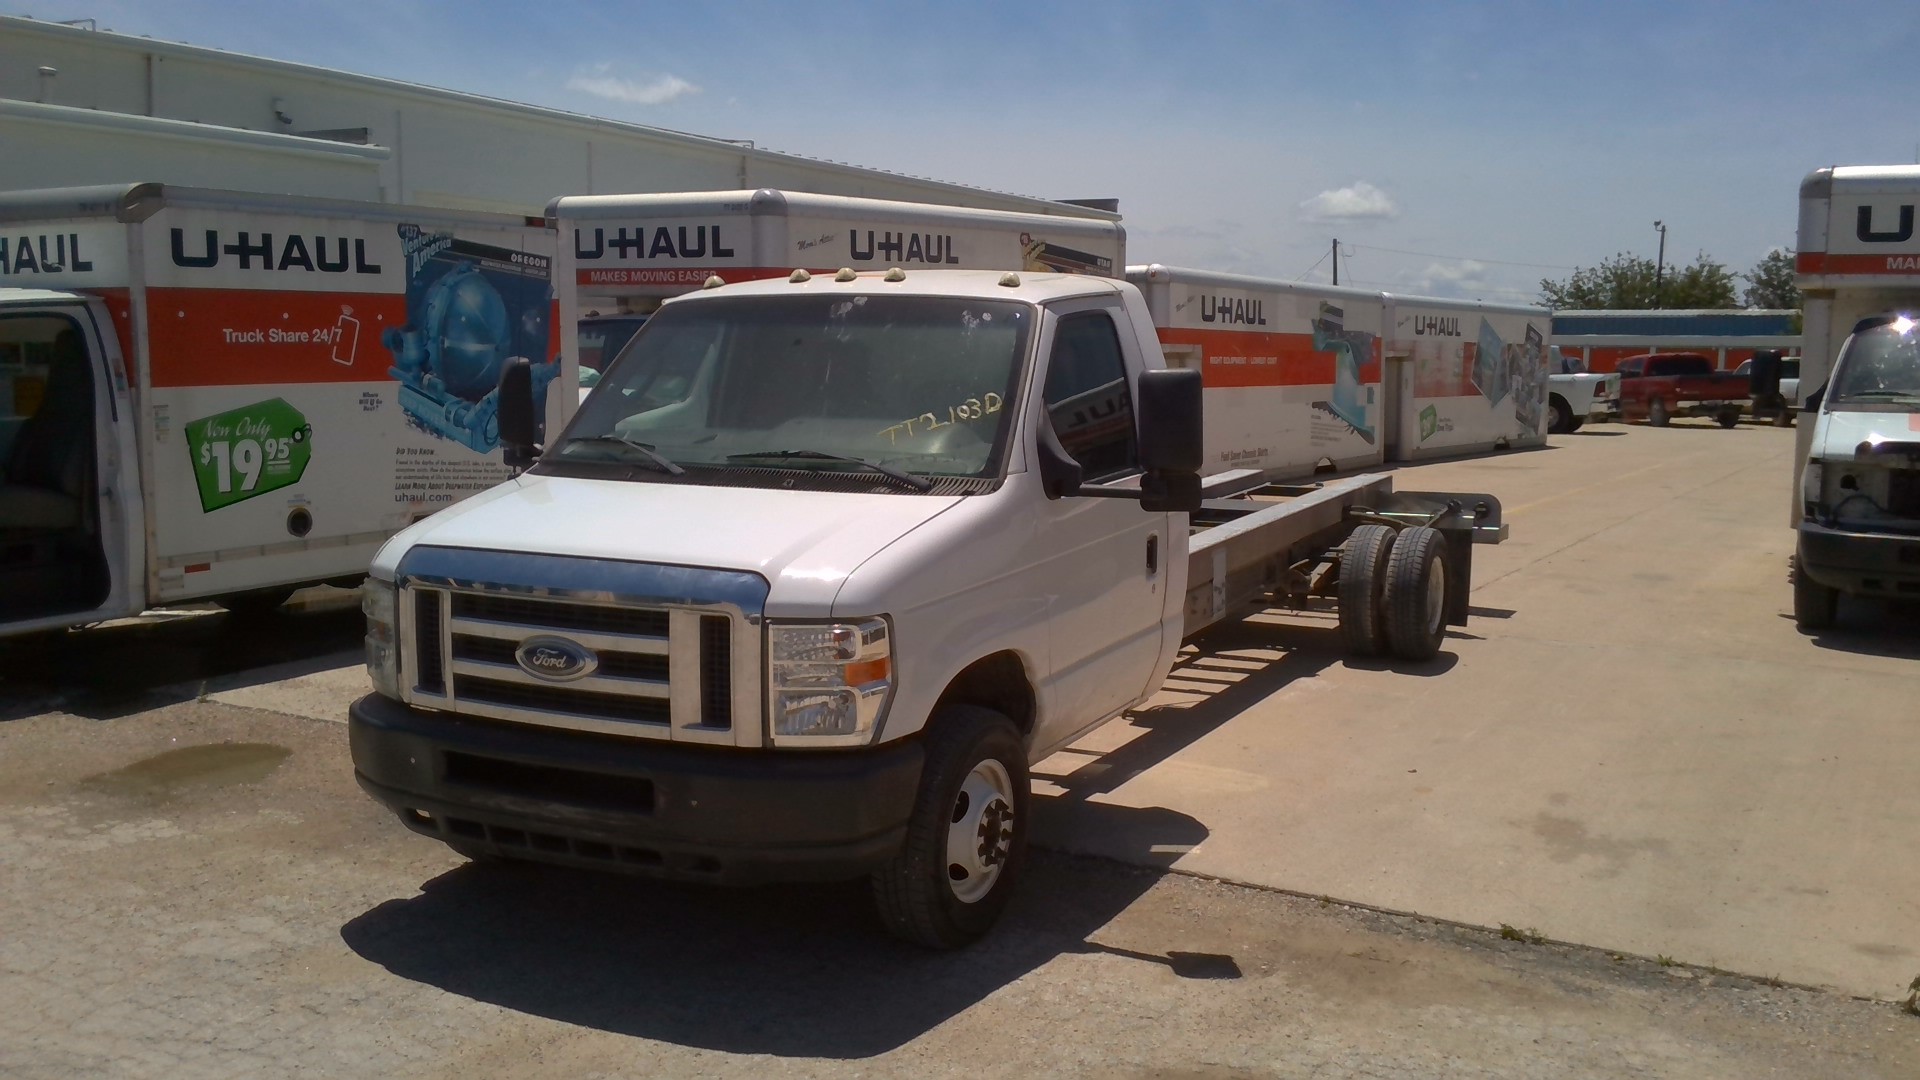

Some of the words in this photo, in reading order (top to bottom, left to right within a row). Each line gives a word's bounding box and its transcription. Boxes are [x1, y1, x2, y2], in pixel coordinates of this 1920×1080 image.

[171, 228, 381, 274] U-HAUL
[575, 226, 734, 259] U-HAUL
[850, 229, 959, 264] U-HAUL
[510, 253, 547, 267] OREGON
[1886, 257, 1920, 270] MA
[591, 271, 628, 282] MAKES
[631, 271, 675, 282] MOVING
[1201, 294, 1266, 325] U-HAUL
[223, 328, 264, 343] Truck
[269, 328, 309, 342] Share
[312, 326, 343, 345] 24/7
[1415, 315, 1462, 337] U-HAUL
[202, 418, 231, 438] Now
[236, 416, 272, 441] Only
[395, 492, 452, 502] uhaul.com
[532, 647, 567, 668] Ford
